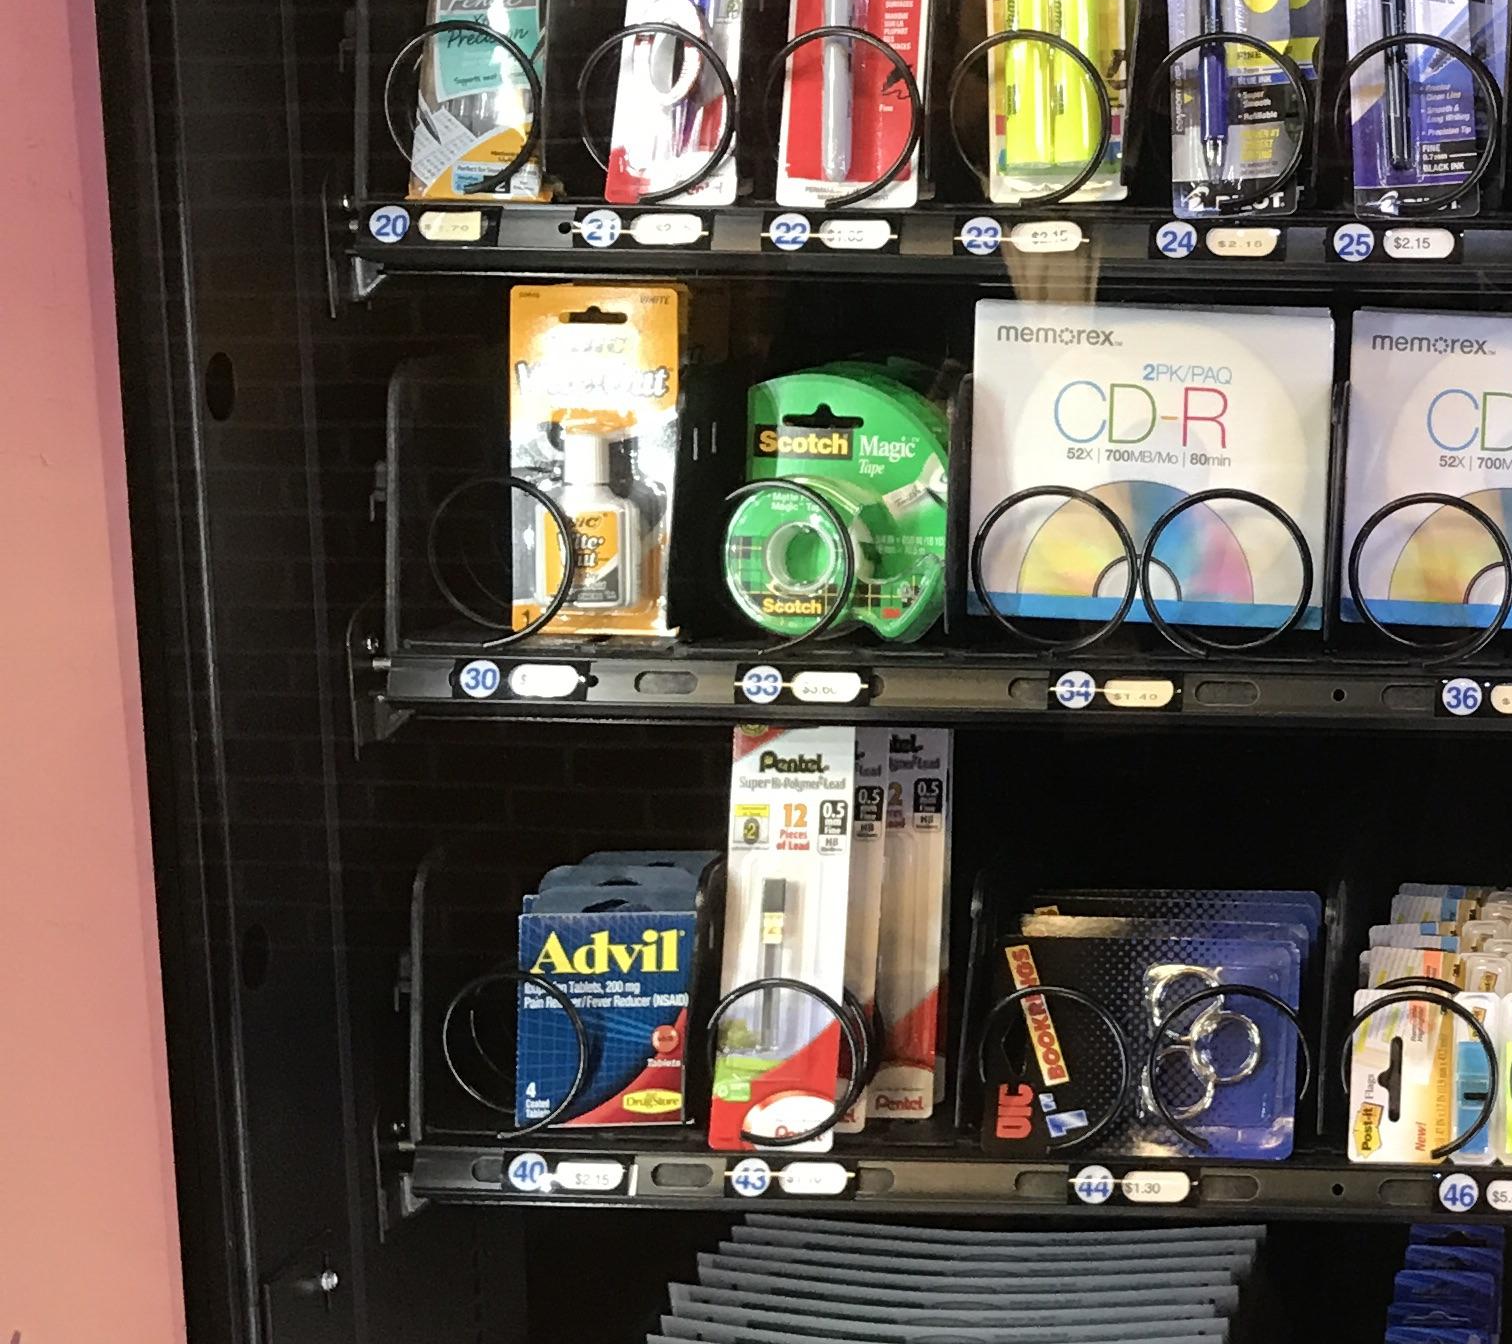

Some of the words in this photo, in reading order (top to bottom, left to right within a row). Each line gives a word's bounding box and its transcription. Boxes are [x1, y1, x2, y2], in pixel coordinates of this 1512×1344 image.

[1161, 230, 1194, 253] 24
[1338, 233, 1371, 256] 25
[1393, 236, 1431, 250] $2.15
[997, 324, 1114, 346] memorex
[1371, 335, 1488, 355] memorex
[1143, 364, 1232, 385] 2PK/PAQ
[1054, 380, 1228, 449] CD-R
[759, 429, 849, 455] Scotch
[859, 435, 912, 459] Magic
[858, 459, 885, 476] Tape
[1066, 447, 1093, 462] 52X
[1105, 448, 1179, 465] 700MB/Mo
[1190, 452, 1232, 467] 80min
[762, 596, 822, 615] Scotch
[464, 667, 498, 690] 30
[1446, 686, 1479, 710] 36
[759, 750, 825, 773] Pentel
[530, 929, 679, 975] Advil
[1364, 1073, 1375, 1100] Flags
[1360, 1107, 1374, 1152] Post-it
[1415, 1121, 1427, 1152] New!
[1443, 1183, 1475, 1206] 46
